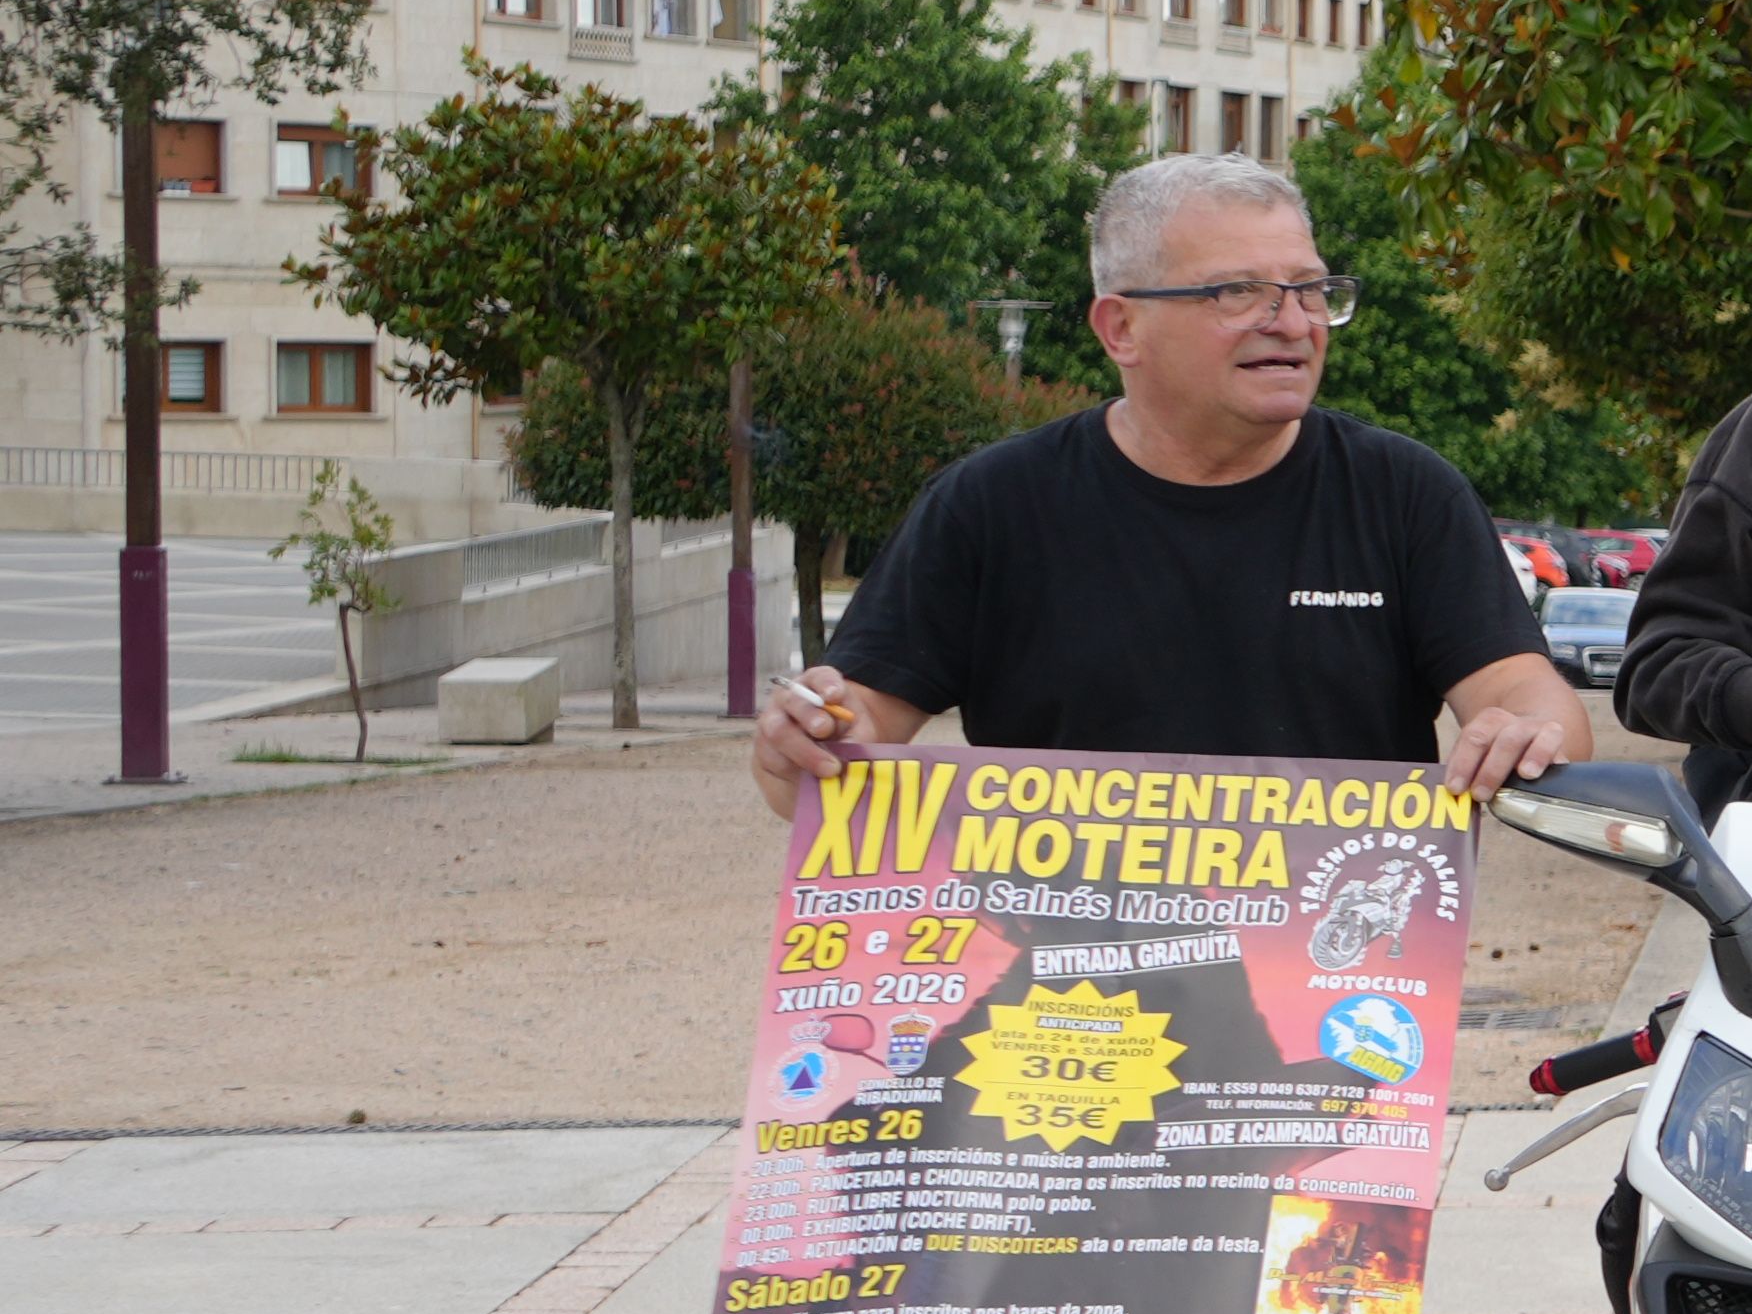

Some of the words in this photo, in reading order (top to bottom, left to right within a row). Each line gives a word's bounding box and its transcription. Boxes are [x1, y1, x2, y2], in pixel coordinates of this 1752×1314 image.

[798, 762, 957, 880] XIV
[967, 763, 1474, 831] CONCENTRACIÓN
[954, 816, 1289, 888] MOTEIRA
[794, 885, 926, 917] Trasnos
[934, 880, 977, 911] do
[986, 881, 1110, 919] Salnés
[1117, 890, 1288, 925] Motoclub
[781, 921, 848, 972] 26
[863, 928, 891, 956] e
[906, 916, 977, 963] 27
[1033, 947, 1131, 975] ENTRADA
[1138, 933, 1240, 968] GRATUÍTA
[775, 978, 864, 1013] xuño
[872, 974, 966, 1006] 2026
